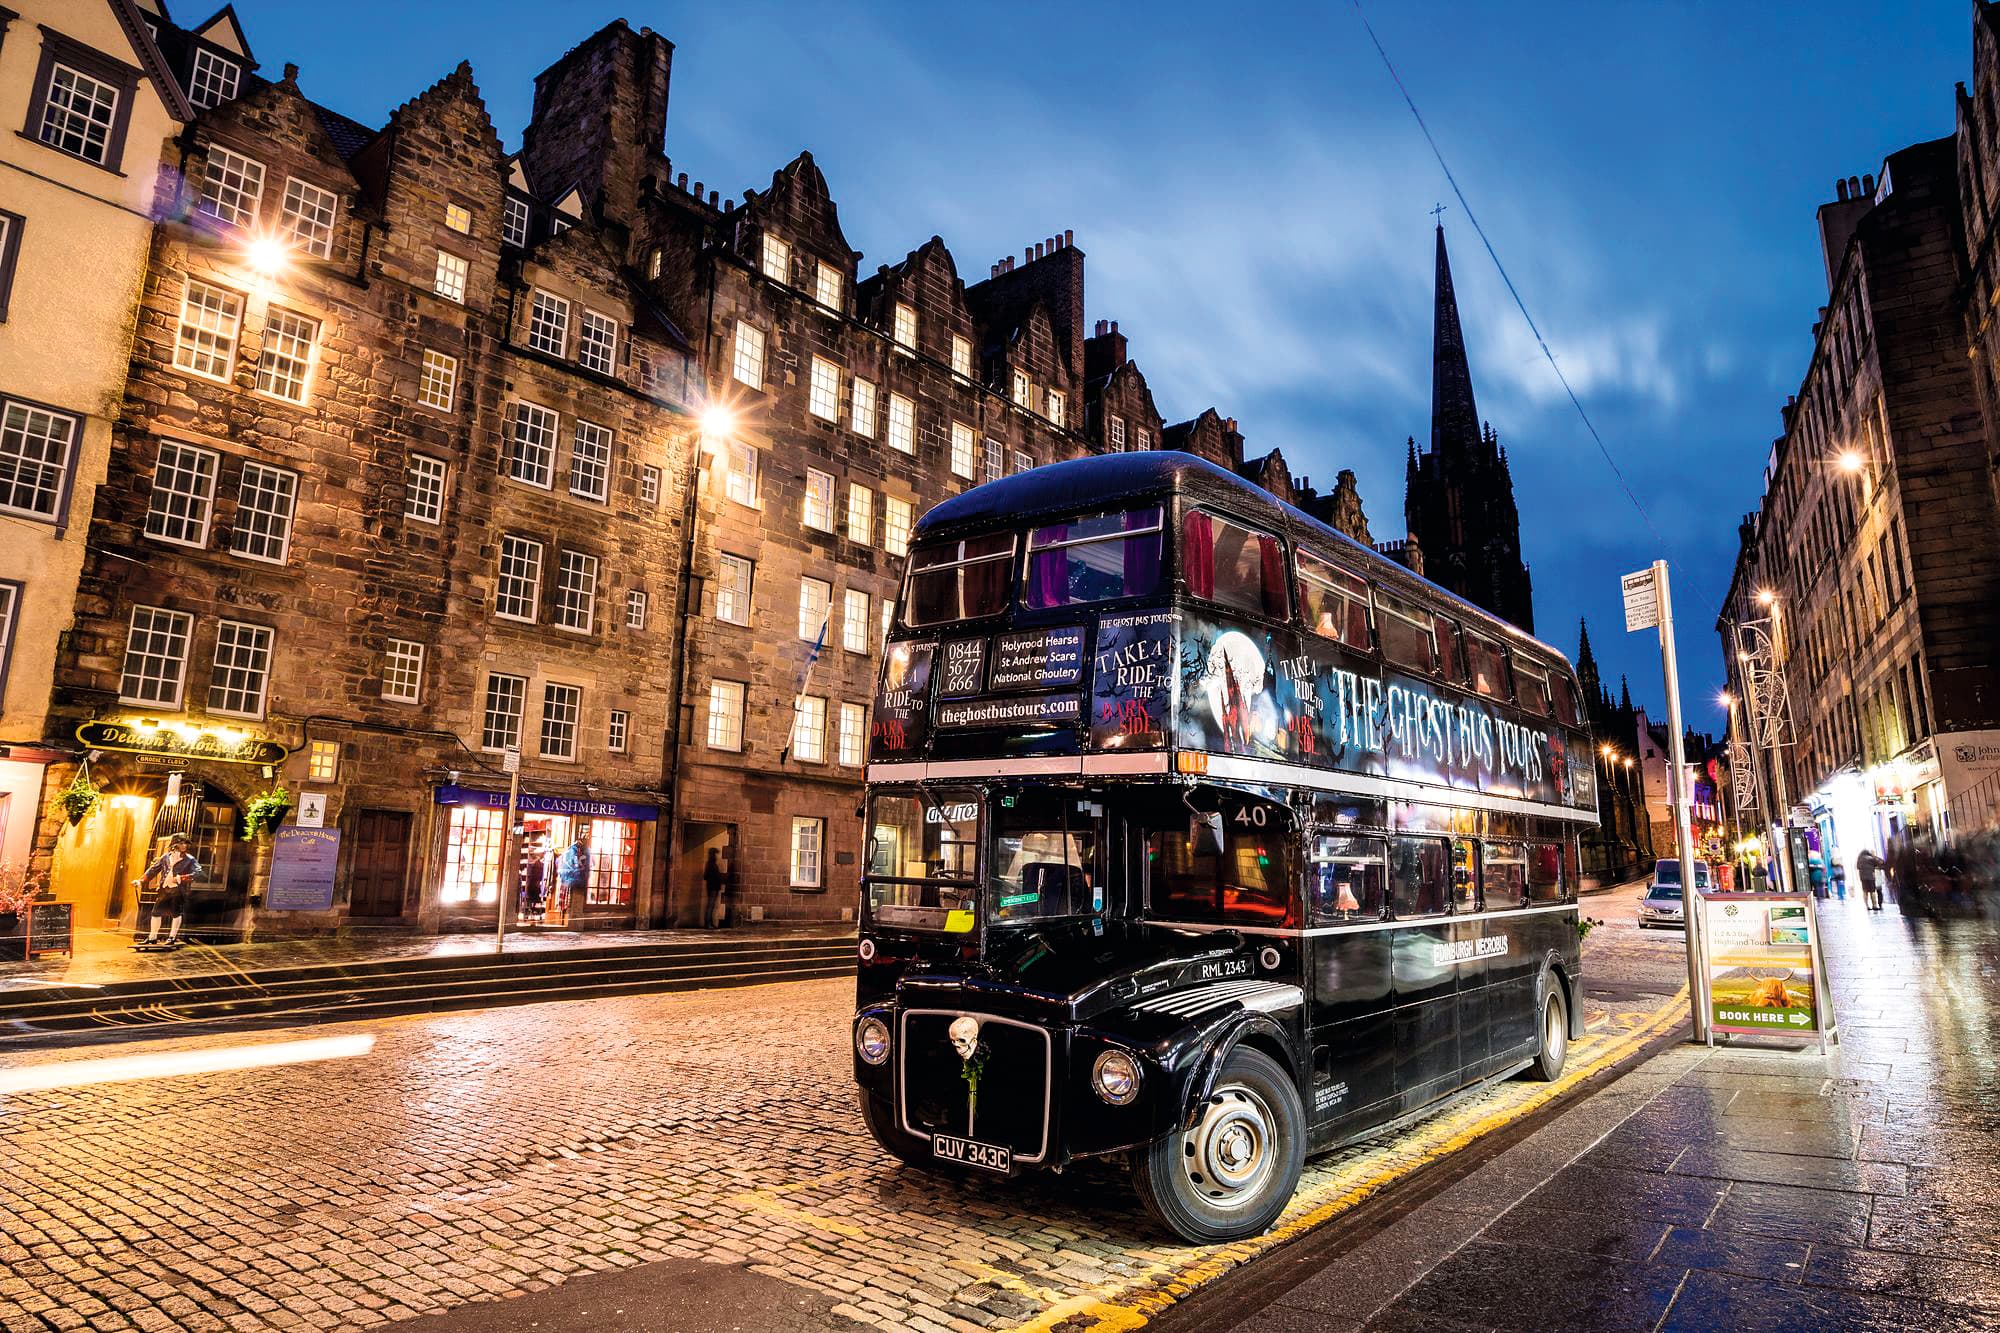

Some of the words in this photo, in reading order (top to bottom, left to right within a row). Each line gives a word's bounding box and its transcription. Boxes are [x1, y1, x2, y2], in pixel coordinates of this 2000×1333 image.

[1100, 619, 1112, 629] THE
[1113, 616, 1135, 628] GHOST
[1135, 615, 1149, 626] BUS
[1150, 613, 1172, 625] TOURS
[948, 641, 982, 660] 0844
[1001, 637, 1043, 653] Holyrood
[1045, 635, 1079, 647] Hearse
[1001, 657, 1011, 668] St
[1012, 655, 1048, 667] Andrew
[1049, 652, 1077, 662] Scare
[1095, 640, 1149, 674] TAKE
[1151, 640, 1162, 656] A
[947, 658, 981, 677] 5677
[993, 670, 1032, 684] National
[1034, 667, 1080, 680] Ghoulery
[1116, 664, 1156, 687] RIDE
[1155, 674, 1173, 688] TO
[1280, 655, 1310, 680] TAKE
[1311, 660, 1317, 676] A
[948, 674, 974, 692] 666
[1131, 686, 1154, 698] THE
[884, 689, 912, 709] RIDE
[911, 700, 924, 711] TO
[1293, 678, 1315, 703] RIDE
[1314, 696, 1324, 711] TO
[894, 708, 910, 719] THE
[941, 699, 1079, 726] theghostbustours.com
[1103, 698, 1153, 720] DARK
[1303, 702, 1315, 719] THE
[872, 720, 906, 737] DARK
[1120, 715, 1152, 736] SIDE
[1287, 715, 1314, 736] DARK
[1332, 667, 1384, 752] THE
[1388, 685, 1455, 766] GHOST
[1458, 707, 1493, 772] BUS
[1495, 717, 1542, 783] TOURS
[102, 728, 177, 748] Deacon's
[181, 735, 232, 753] House
[883, 735, 907, 751] SIDE
[1298, 734, 1321, 755] SIDE
[541, 798, 617, 816] CASHMERE
[1235, 806, 1267, 828] 40
[1433, 939, 1474, 965] EDINBURGH
[1475, 935, 1509, 956] NECROBUS
[1202, 963, 1223, 979] RML
[1225, 960, 1247, 975] 2343
[1719, 1010, 1751, 1022] BOOK
[1753, 1012, 1785, 1023] HERE
[936, 1137, 965, 1159] CUV
[968, 1144, 1007, 1169] 343C
